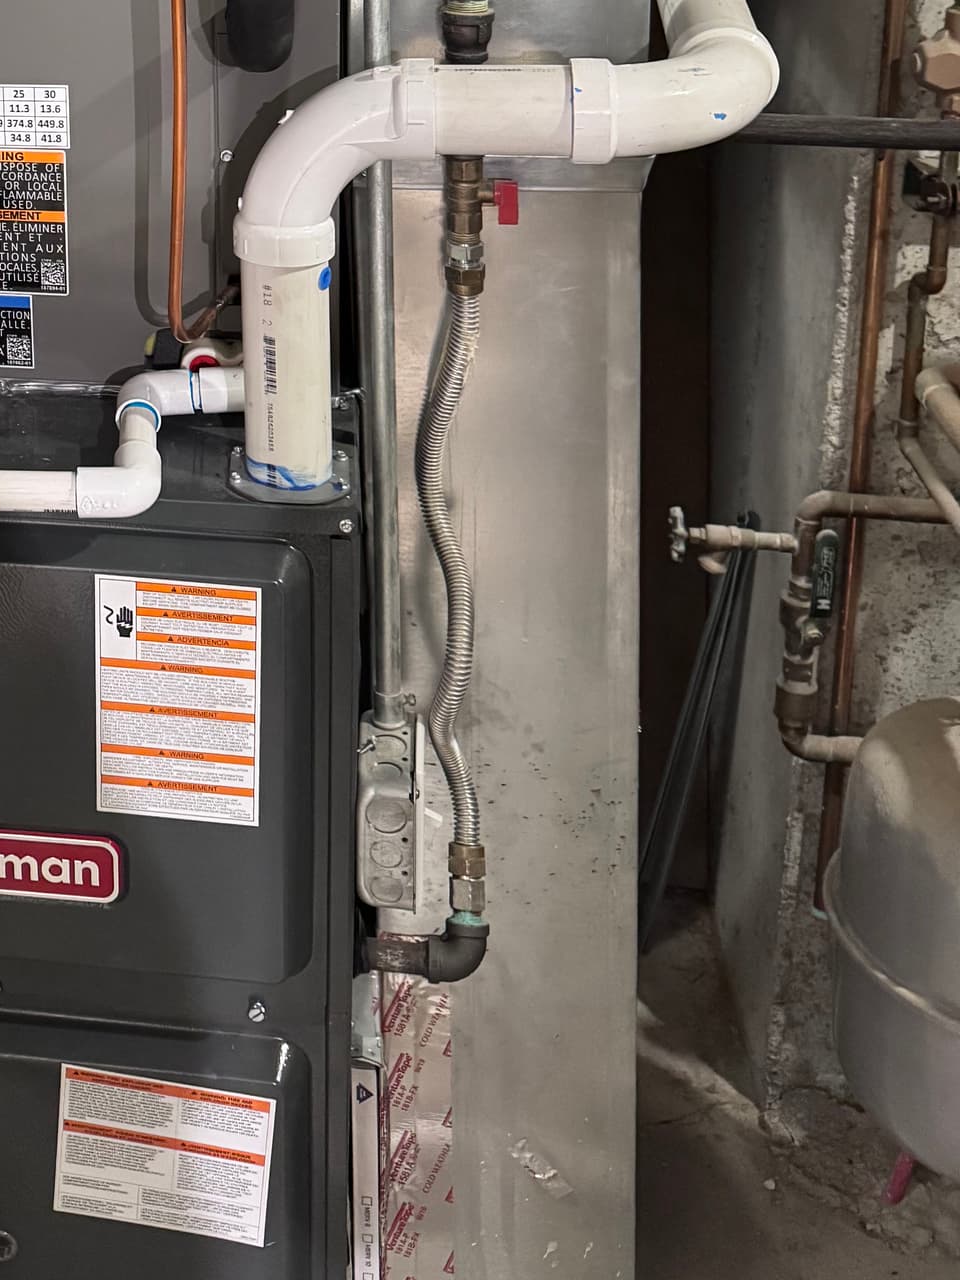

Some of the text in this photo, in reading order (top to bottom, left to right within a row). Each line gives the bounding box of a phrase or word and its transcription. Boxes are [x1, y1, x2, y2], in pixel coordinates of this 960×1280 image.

[13, 90, 25, 99] 25
[44, 90, 56, 99] 30
[9, 103, 30, 112] 11.3
[40, 104, 61, 113] 13.6
[7, 119, 33, 128] 374.8
[37, 120, 64, 128] 449.8
[10, 133, 31, 143] 34.8
[40, 134, 62, 143] 41.8
[180, 588, 217, 596] WARNING
[172, 612, 233, 622] AVERTISSEMENT
[177, 637, 229, 646] ADVERTENCIA
[167, 664, 204, 674] WARNING
[158, 708, 218, 718] AVERTISSEMENT
[169, 751, 204, 760] WARNING
[158, 782, 218, 792] AVERTISSEMENT
[420, 1026, 434, 1047] COLD
[389, 1053, 412, 1100] entureTape
[423, 1175, 436, 1194] COLD
